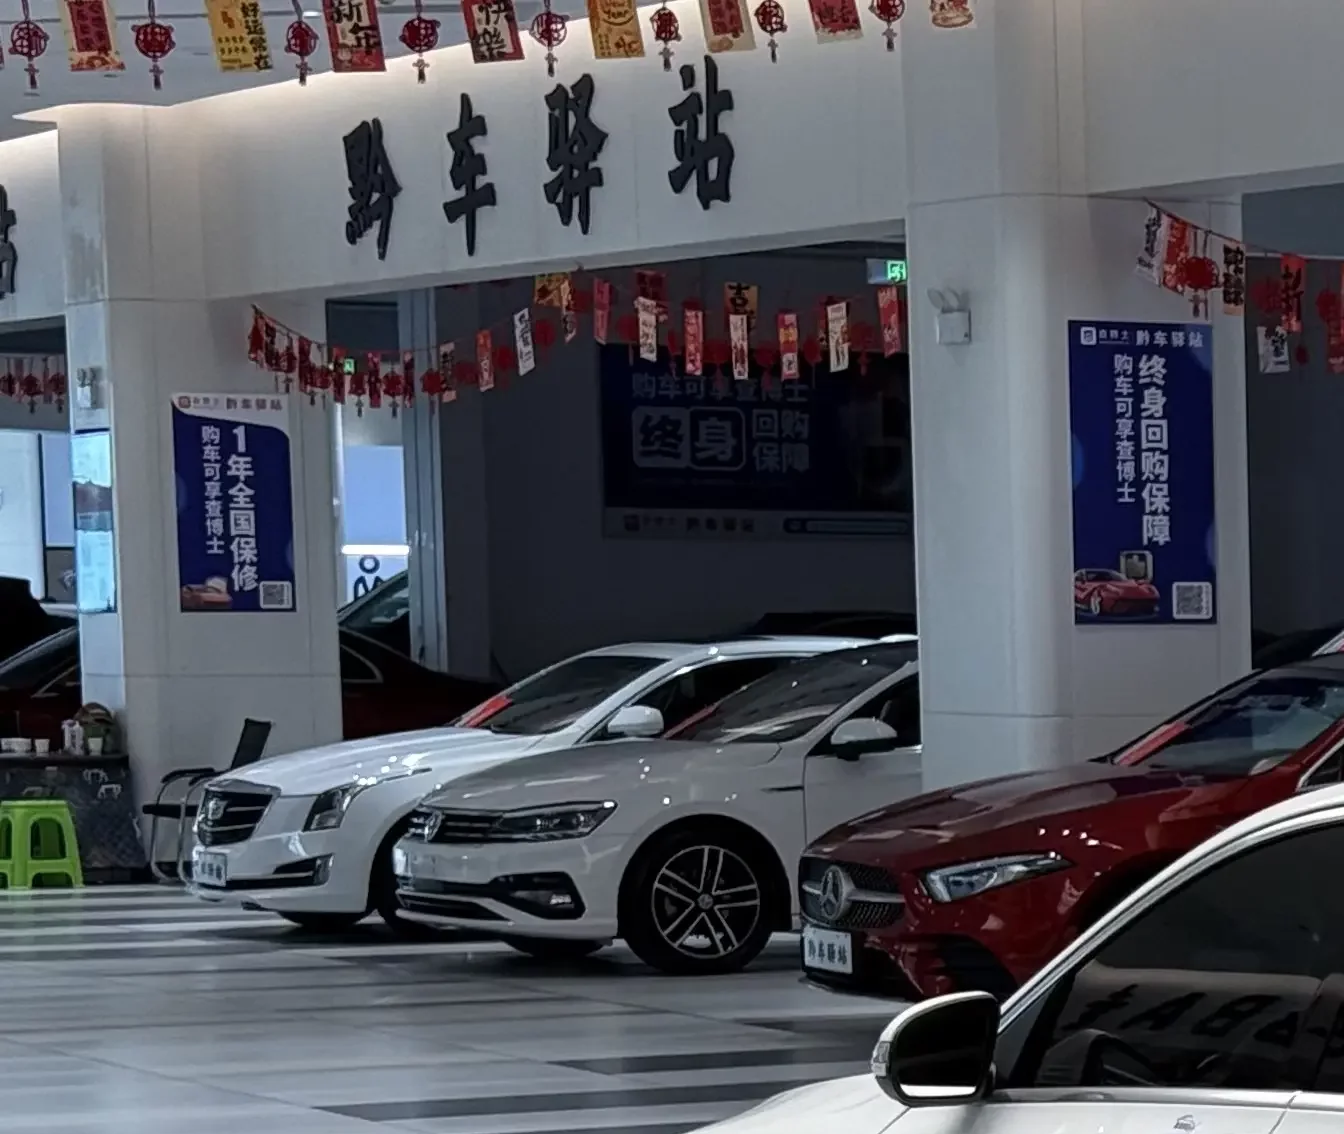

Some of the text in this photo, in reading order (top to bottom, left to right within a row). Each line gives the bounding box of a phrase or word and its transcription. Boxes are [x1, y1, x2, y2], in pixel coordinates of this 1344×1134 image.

[343, 54, 735, 261] 黔车驿站
[227, 424, 259, 592] 1年全国保修
[1114, 354, 1136, 503] 购车可享查博士
[1138, 354, 1171, 546] 终身回购保障
